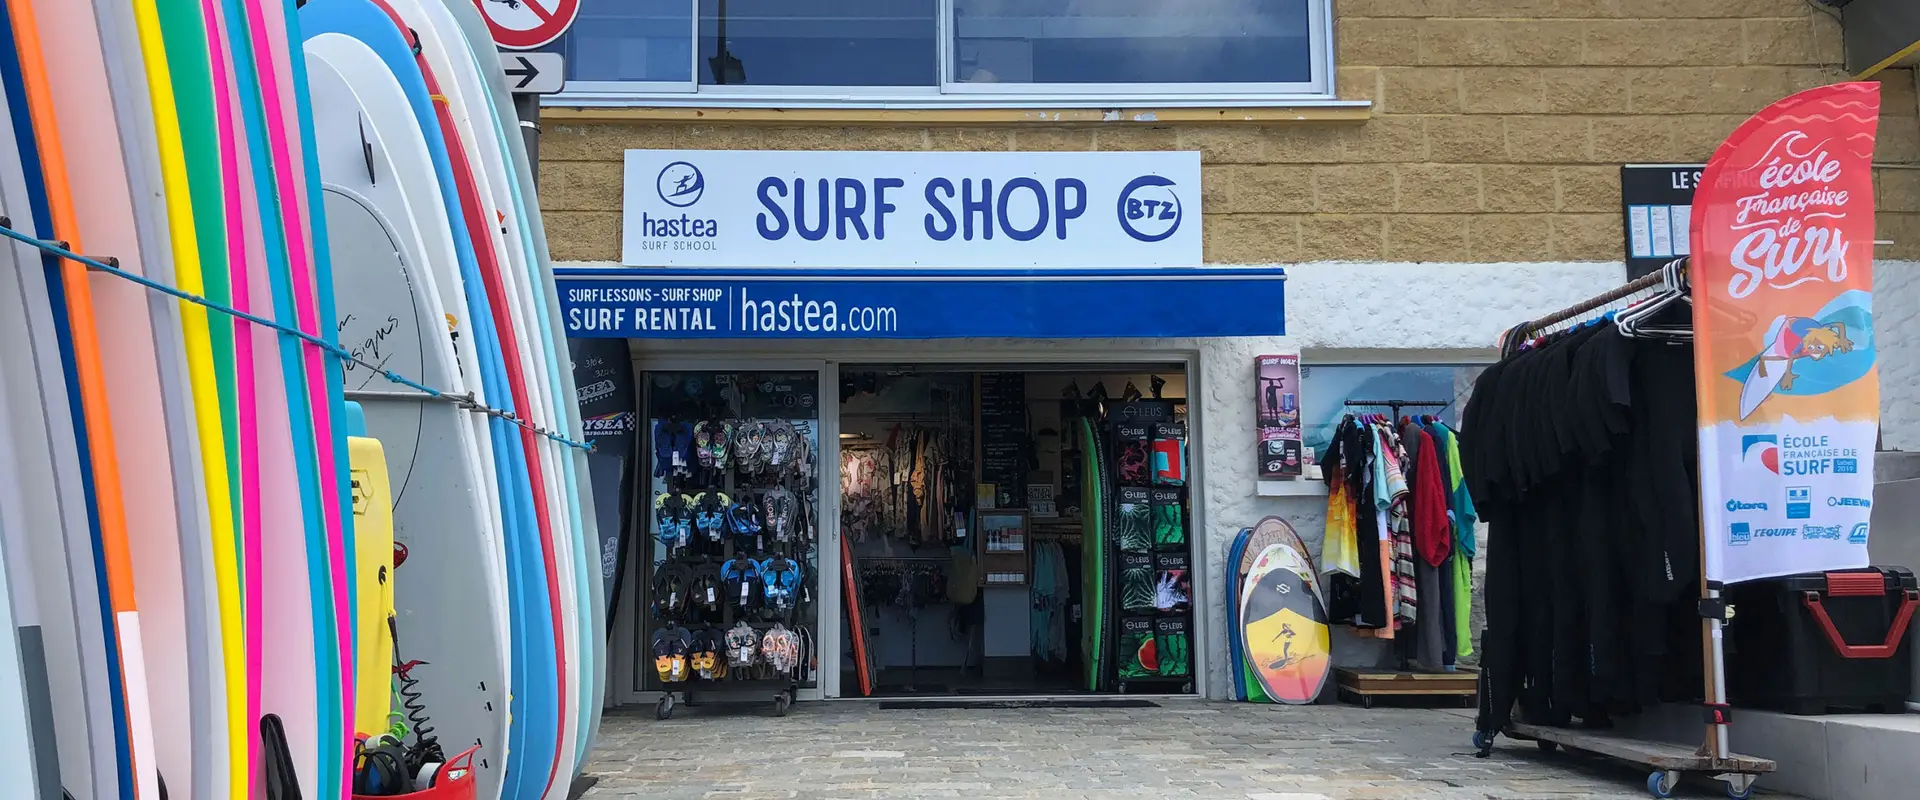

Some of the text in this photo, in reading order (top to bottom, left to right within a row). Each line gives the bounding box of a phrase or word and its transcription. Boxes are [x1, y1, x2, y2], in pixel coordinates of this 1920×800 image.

[1760, 150, 1842, 189] école
[1671, 171, 1689, 189] LE
[756, 176, 1087, 241] SURF SHOP
[1126, 197, 1177, 221] BTZ
[1736, 186, 1849, 223] Française
[643, 211, 718, 237] hastea
[1779, 217, 1802, 238] de
[642, 240, 717, 251] SURF SCHOOL
[1728, 225, 1849, 299] Surf
[568, 288, 599, 303] SURF
[600, 288, 652, 302] LESSONS
[661, 288, 691, 302] SURF
[692, 288, 723, 302] SHOP
[742, 287, 897, 332] hastea.com
[569, 307, 717, 331] SURF RENTAL
[1262, 358, 1280, 366] SURF
[577, 380, 612, 399] YSEA
[1139, 407, 1162, 417] LEUS
[581, 420, 624, 430] YSEA
[1167, 427, 1182, 435] LEUS
[1783, 434, 1829, 448] ÉCOLE
[1783, 448, 1857, 459] FRANÇAISE DE
[1783, 458, 1831, 476] SURF
[1163, 492, 1178, 500] LEUS
[1169, 557, 1184, 565] LEUS
[1134, 621, 1149, 629] LEUS
[1168, 622, 1183, 630] LEUS
